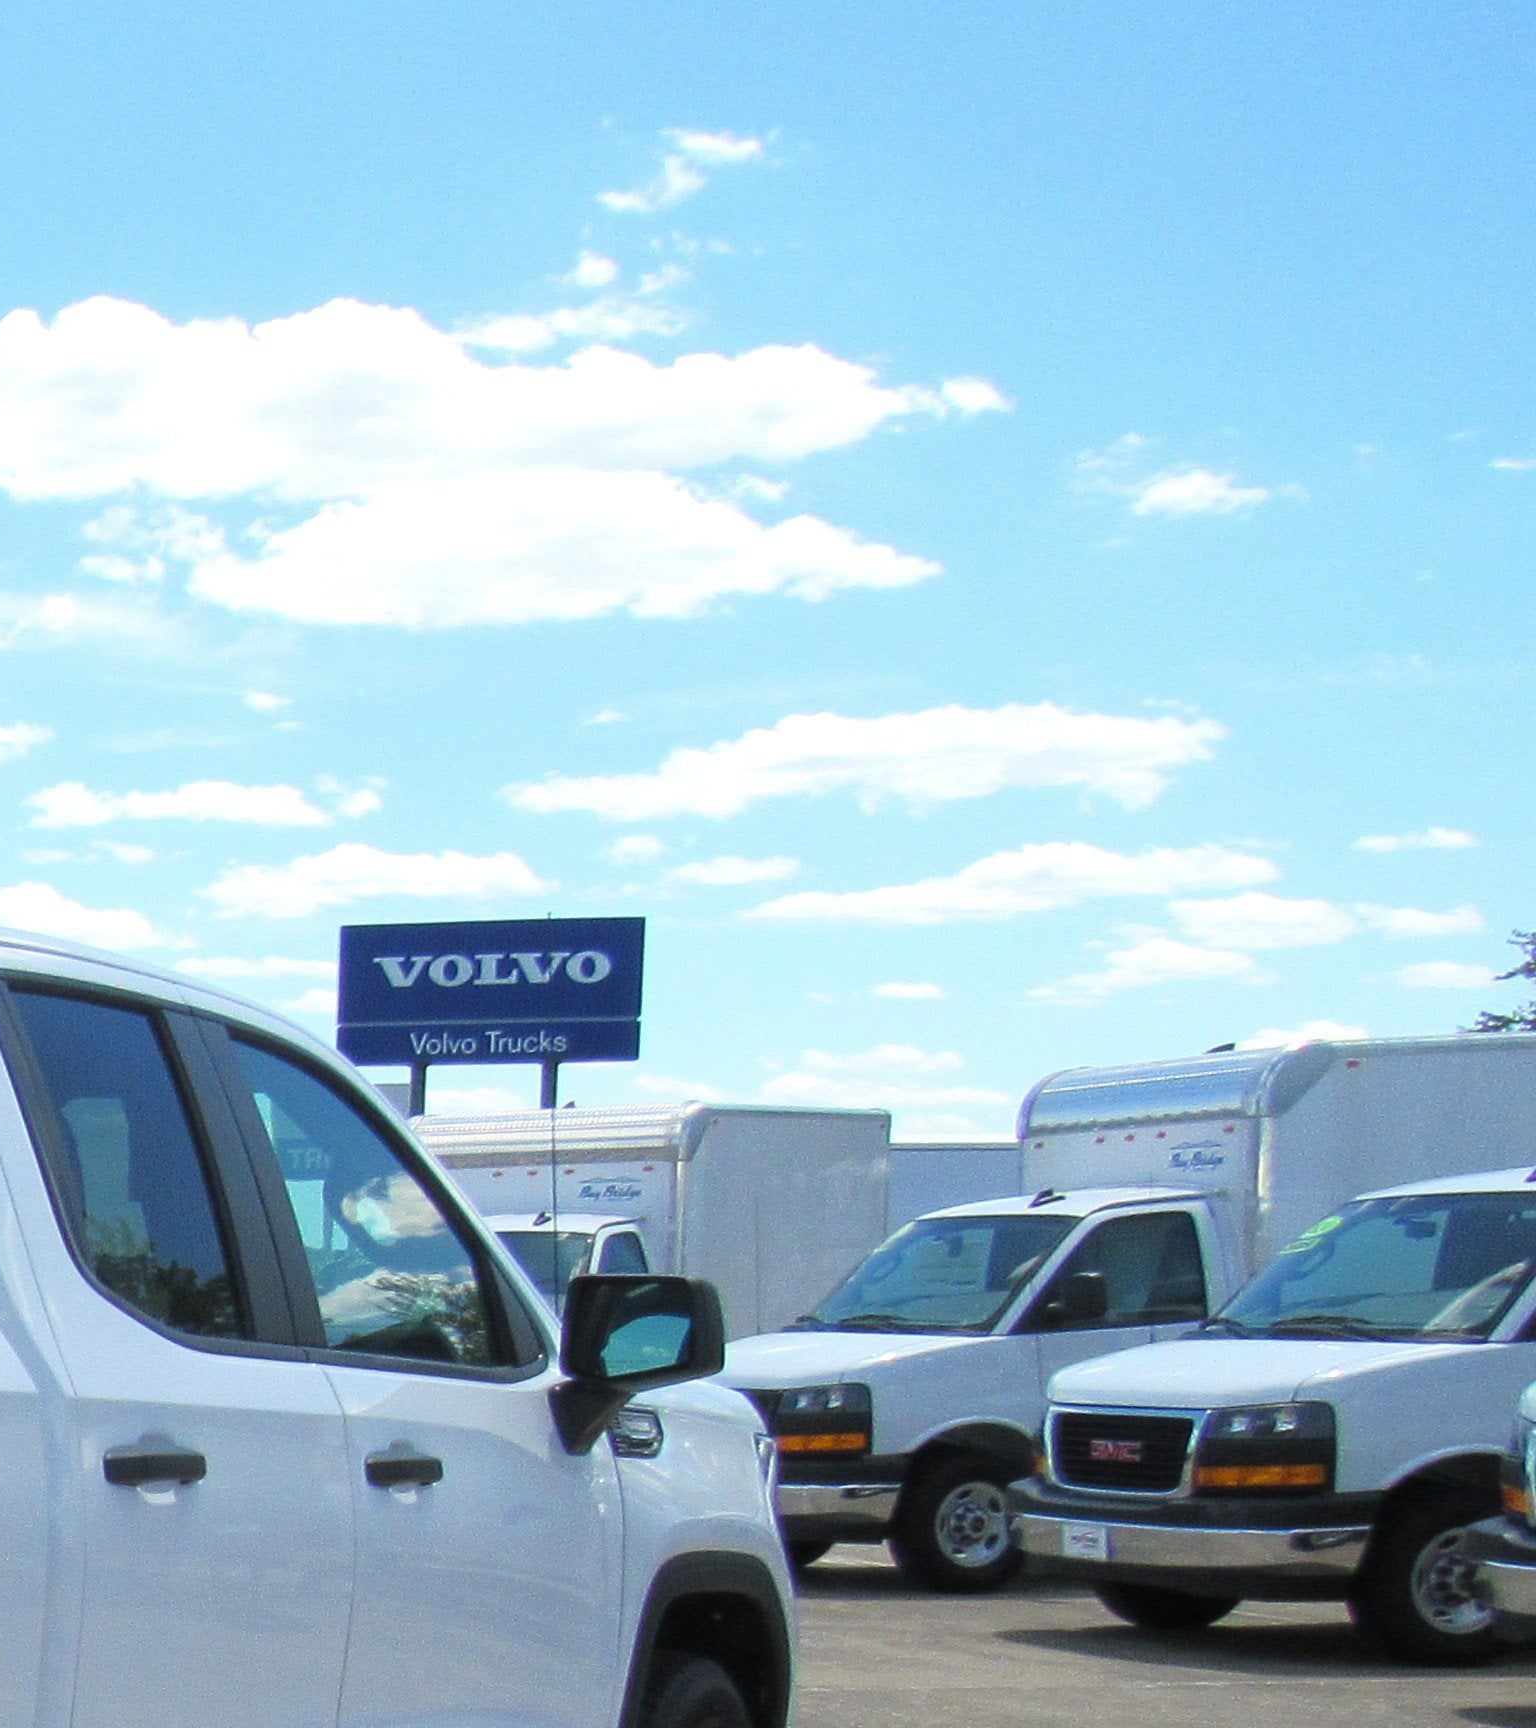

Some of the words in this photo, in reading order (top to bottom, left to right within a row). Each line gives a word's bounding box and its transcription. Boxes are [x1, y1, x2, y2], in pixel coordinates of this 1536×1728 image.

[372, 949, 612, 988] VOLVO
[409, 1032, 477, 1055] Volvo
[484, 1030, 569, 1054] Trucks
[1088, 1439, 1143, 1464] GMC
